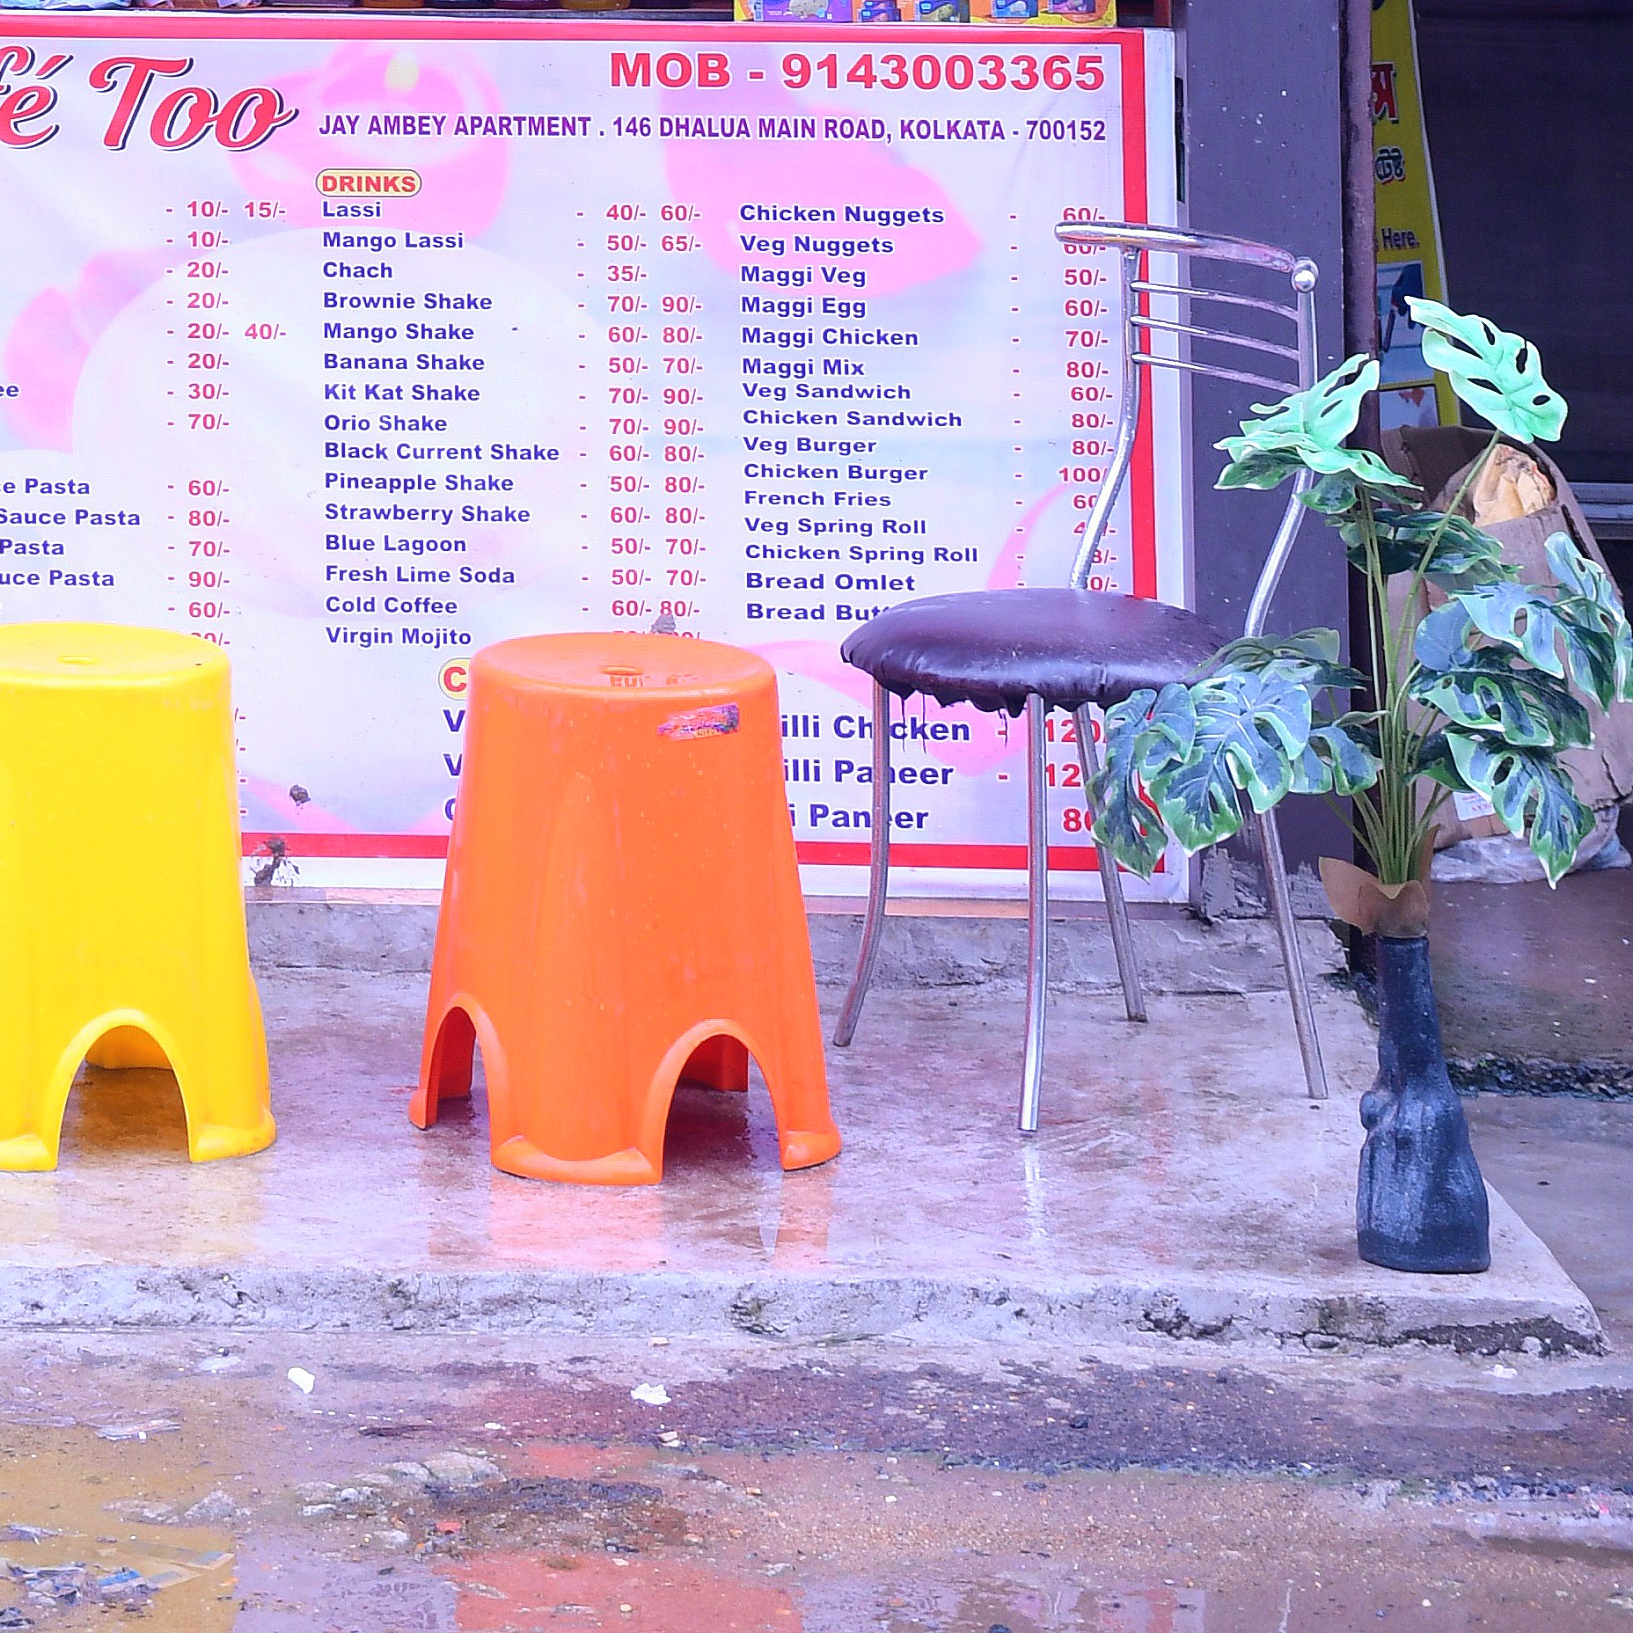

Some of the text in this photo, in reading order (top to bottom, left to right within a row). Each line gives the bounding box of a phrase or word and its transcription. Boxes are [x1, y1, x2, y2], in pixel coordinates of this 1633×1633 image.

[88, 53, 300, 154] Too
[610, 52, 730, 88] MOB
[780, 52, 1107, 93] 9143003365
[318, 114, 1106, 144] JAY AMBEY APARTMENT 146 DHALUA MAIN ROAD, KOLKATA 700152
[322, 173, 419, 194] DRINKS
[187, 200, 228, 217] 10/-
[244, 201, 286, 218] 15/-
[323, 200, 381, 218] Lassi
[740, 204, 944, 227] Chicken Nuggets
[323, 231, 701, 252] Mango Lassi 50/- 65/-
[739, 235, 894, 257] Veg Nuggets
[323, 261, 393, 278] Chach
[741, 265, 866, 288] Maggi Veg
[323, 292, 702, 313] Brownie Shake 70/- 90/-
[741, 296, 866, 319] Maggi Egg
[187, 322, 229, 340] 20/-
[244, 323, 286, 340] 40/-
[324, 322, 474, 344] Mango Shake
[742, 327, 918, 349] Maggi Chicken
[324, 353, 485, 371] Banana Shake
[742, 357, 865, 379] Maggi Mix
[324, 383, 480, 401] Kit Kat Shake
[742, 382, 911, 402] Veg Sandwich
[324, 414, 447, 432] Orio Shake
[743, 409, 962, 427] Chicken Sandwich
[325, 442, 560, 461] Black Current Shake
[743, 436, 877, 456] Veg Burger
[325, 472, 514, 494] Pineapple Shake
[744, 463, 928, 484] Chicken Burger
[25, 478, 90, 495] Pasta
[744, 490, 891, 507] French Fries
[325, 503, 530, 526] Strawberry Shake
[744, 517, 926, 538] Veg Spring Roll
[325, 534, 466, 556] Blue Lagoon
[745, 544, 978, 565] Chicken Spring Roll
[326, 565, 515, 584] Fresh Lime Soda
[746, 572, 915, 591] Bread Omlet
[326, 596, 458, 614] Cold Coffee
[325, 627, 472, 649] Virgin Mojito
